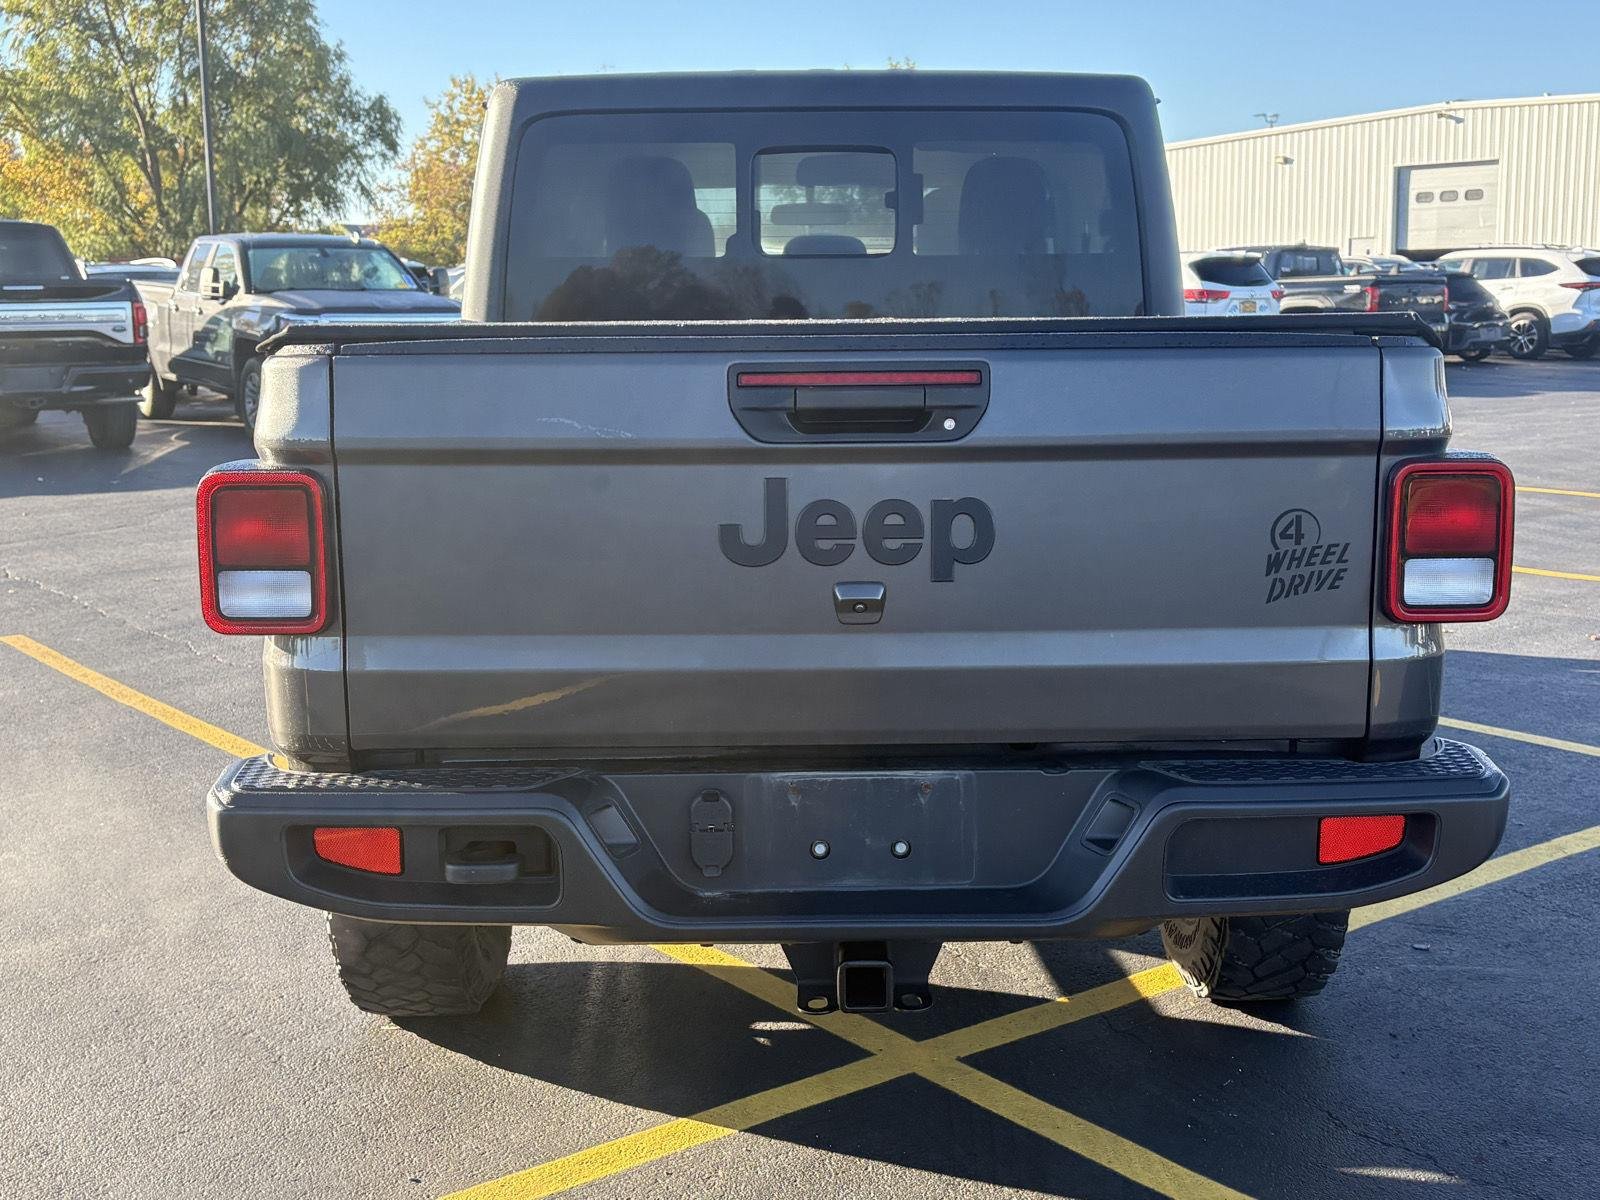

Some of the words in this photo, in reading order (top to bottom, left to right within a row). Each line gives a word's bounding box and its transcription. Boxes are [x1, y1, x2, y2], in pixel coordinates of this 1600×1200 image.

[718, 477, 995, 582] Jeep
[1279, 514, 1305, 546] 4
[1265, 542, 1351, 577] WHEEL
[1265, 567, 1349, 605] DRIVE
